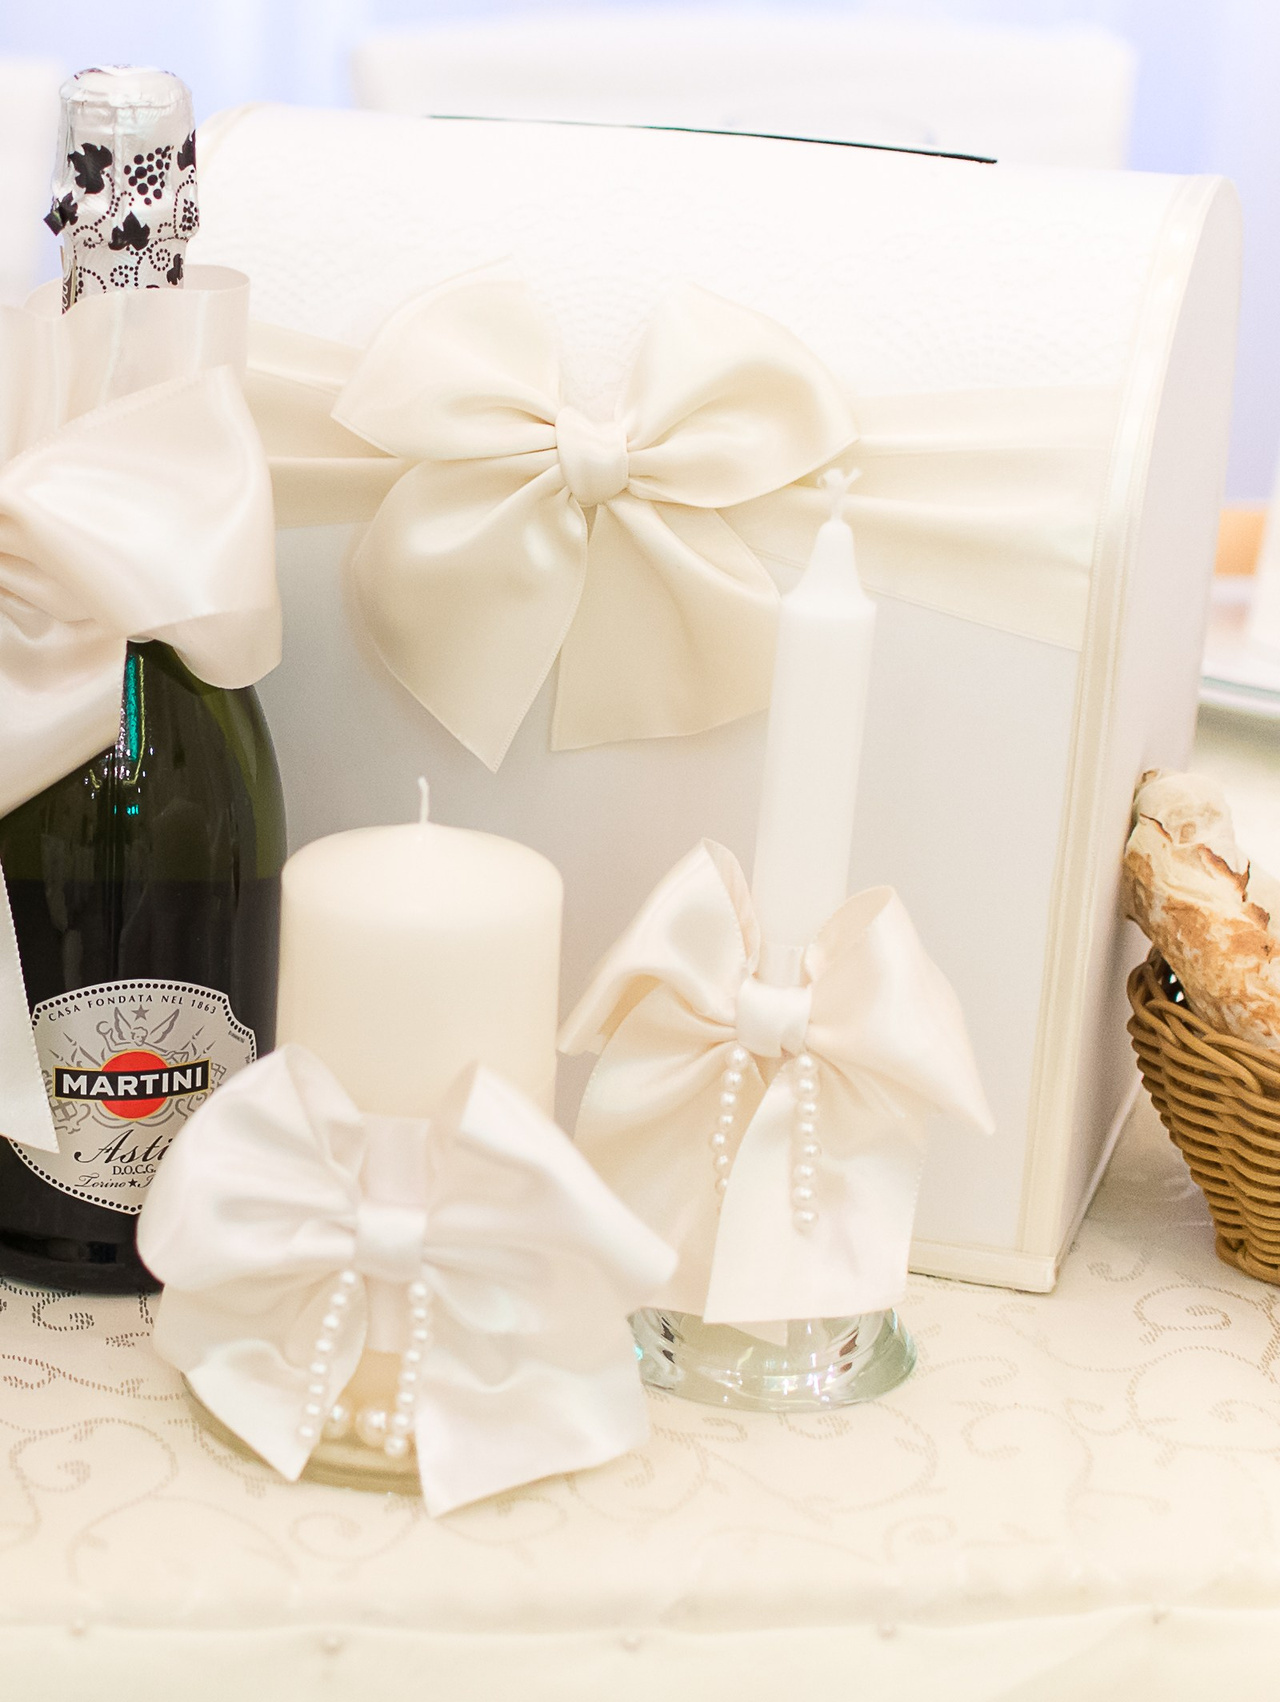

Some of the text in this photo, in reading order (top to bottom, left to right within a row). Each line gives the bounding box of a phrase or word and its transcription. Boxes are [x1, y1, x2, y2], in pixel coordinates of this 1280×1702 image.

[48, 994, 217, 1022] CASA FONDATA NEL 1863
[62, 1066, 203, 1096] MARTINI
[73, 1129, 173, 1164] Asti
[74, 1172, 126, 1188] Torino
[112, 1163, 157, 1175] D.O.C.G.
